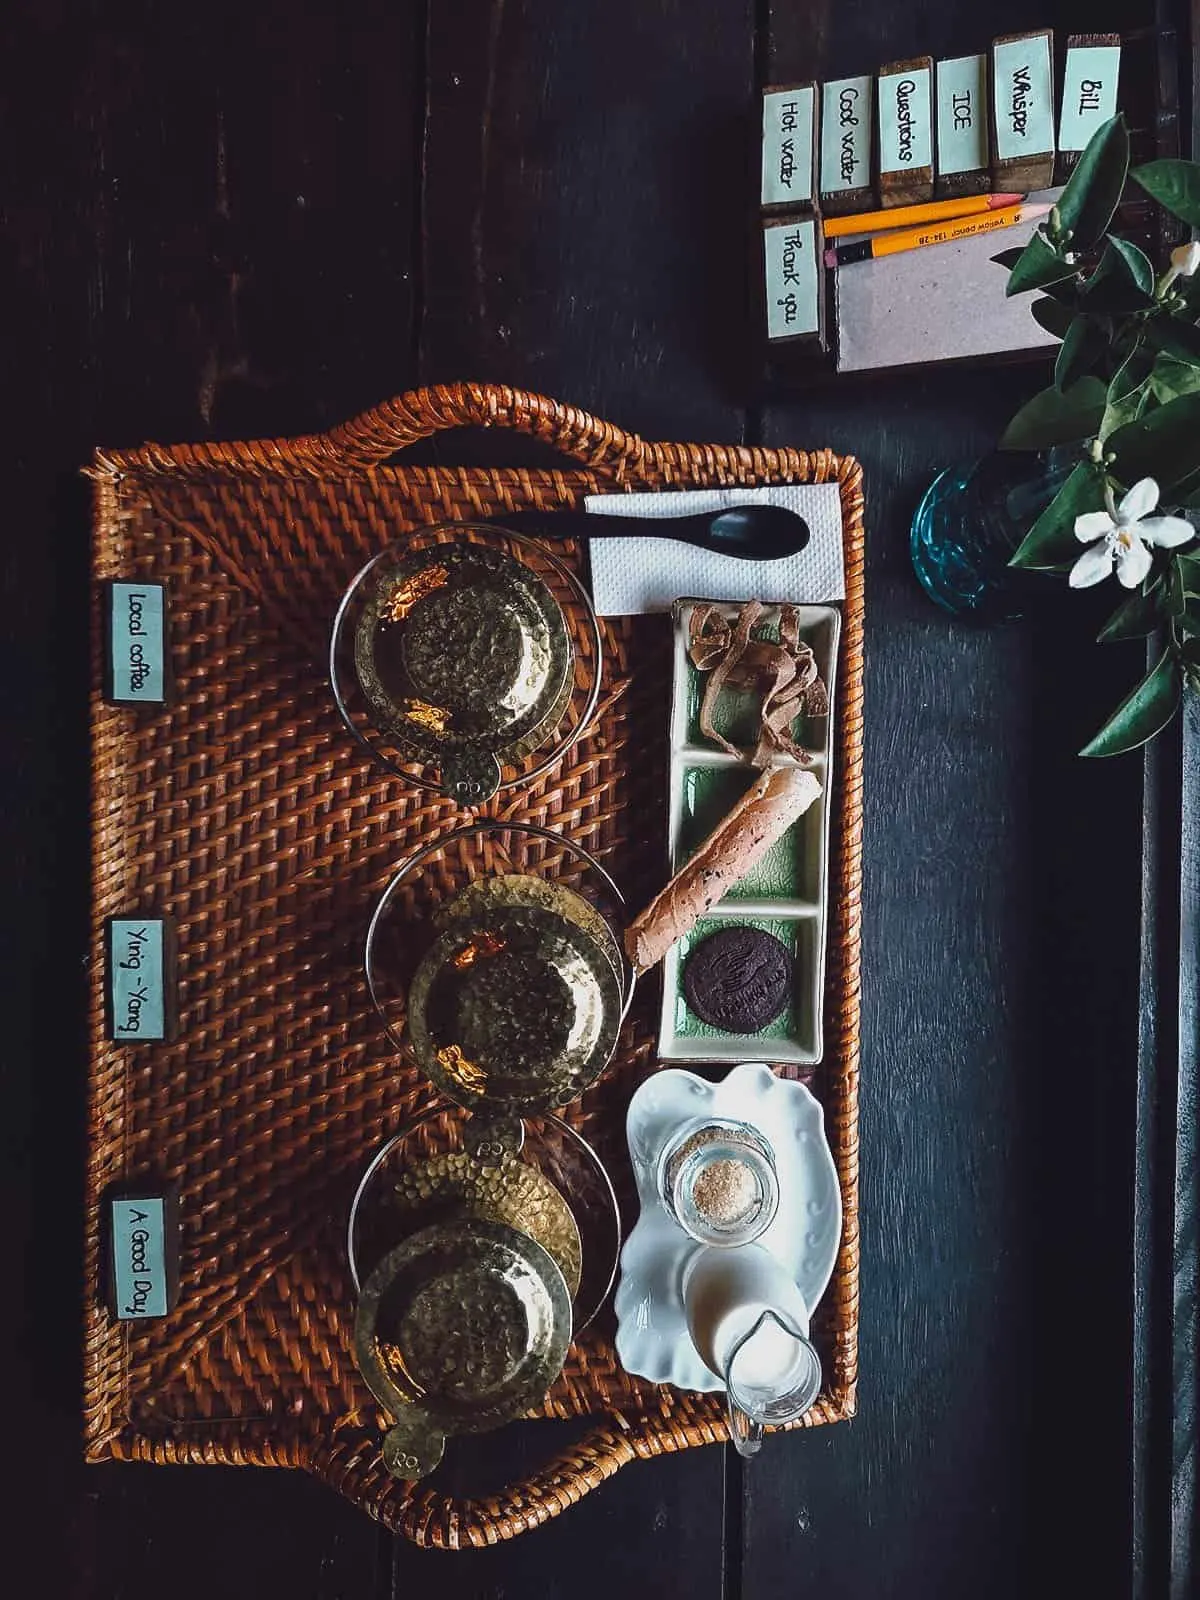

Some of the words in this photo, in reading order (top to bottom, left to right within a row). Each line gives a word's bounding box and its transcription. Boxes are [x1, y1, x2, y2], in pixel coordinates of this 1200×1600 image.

[781, 102, 799, 133] Hot
[840, 88, 860, 127] Cool
[896, 80, 917, 162] Questions
[952, 90, 972, 130] ICE
[1008, 65, 1034, 137] Whisper
[780, 138, 798, 189] water
[841, 131, 860, 184] water
[777, 293, 798, 324] you
[128, 593, 148, 636] Local
[129, 643, 151, 693] coffee
[129, 1208, 149, 1224] A
[131, 1229, 152, 1273] Good
[125, 1280, 153, 1315] Day
